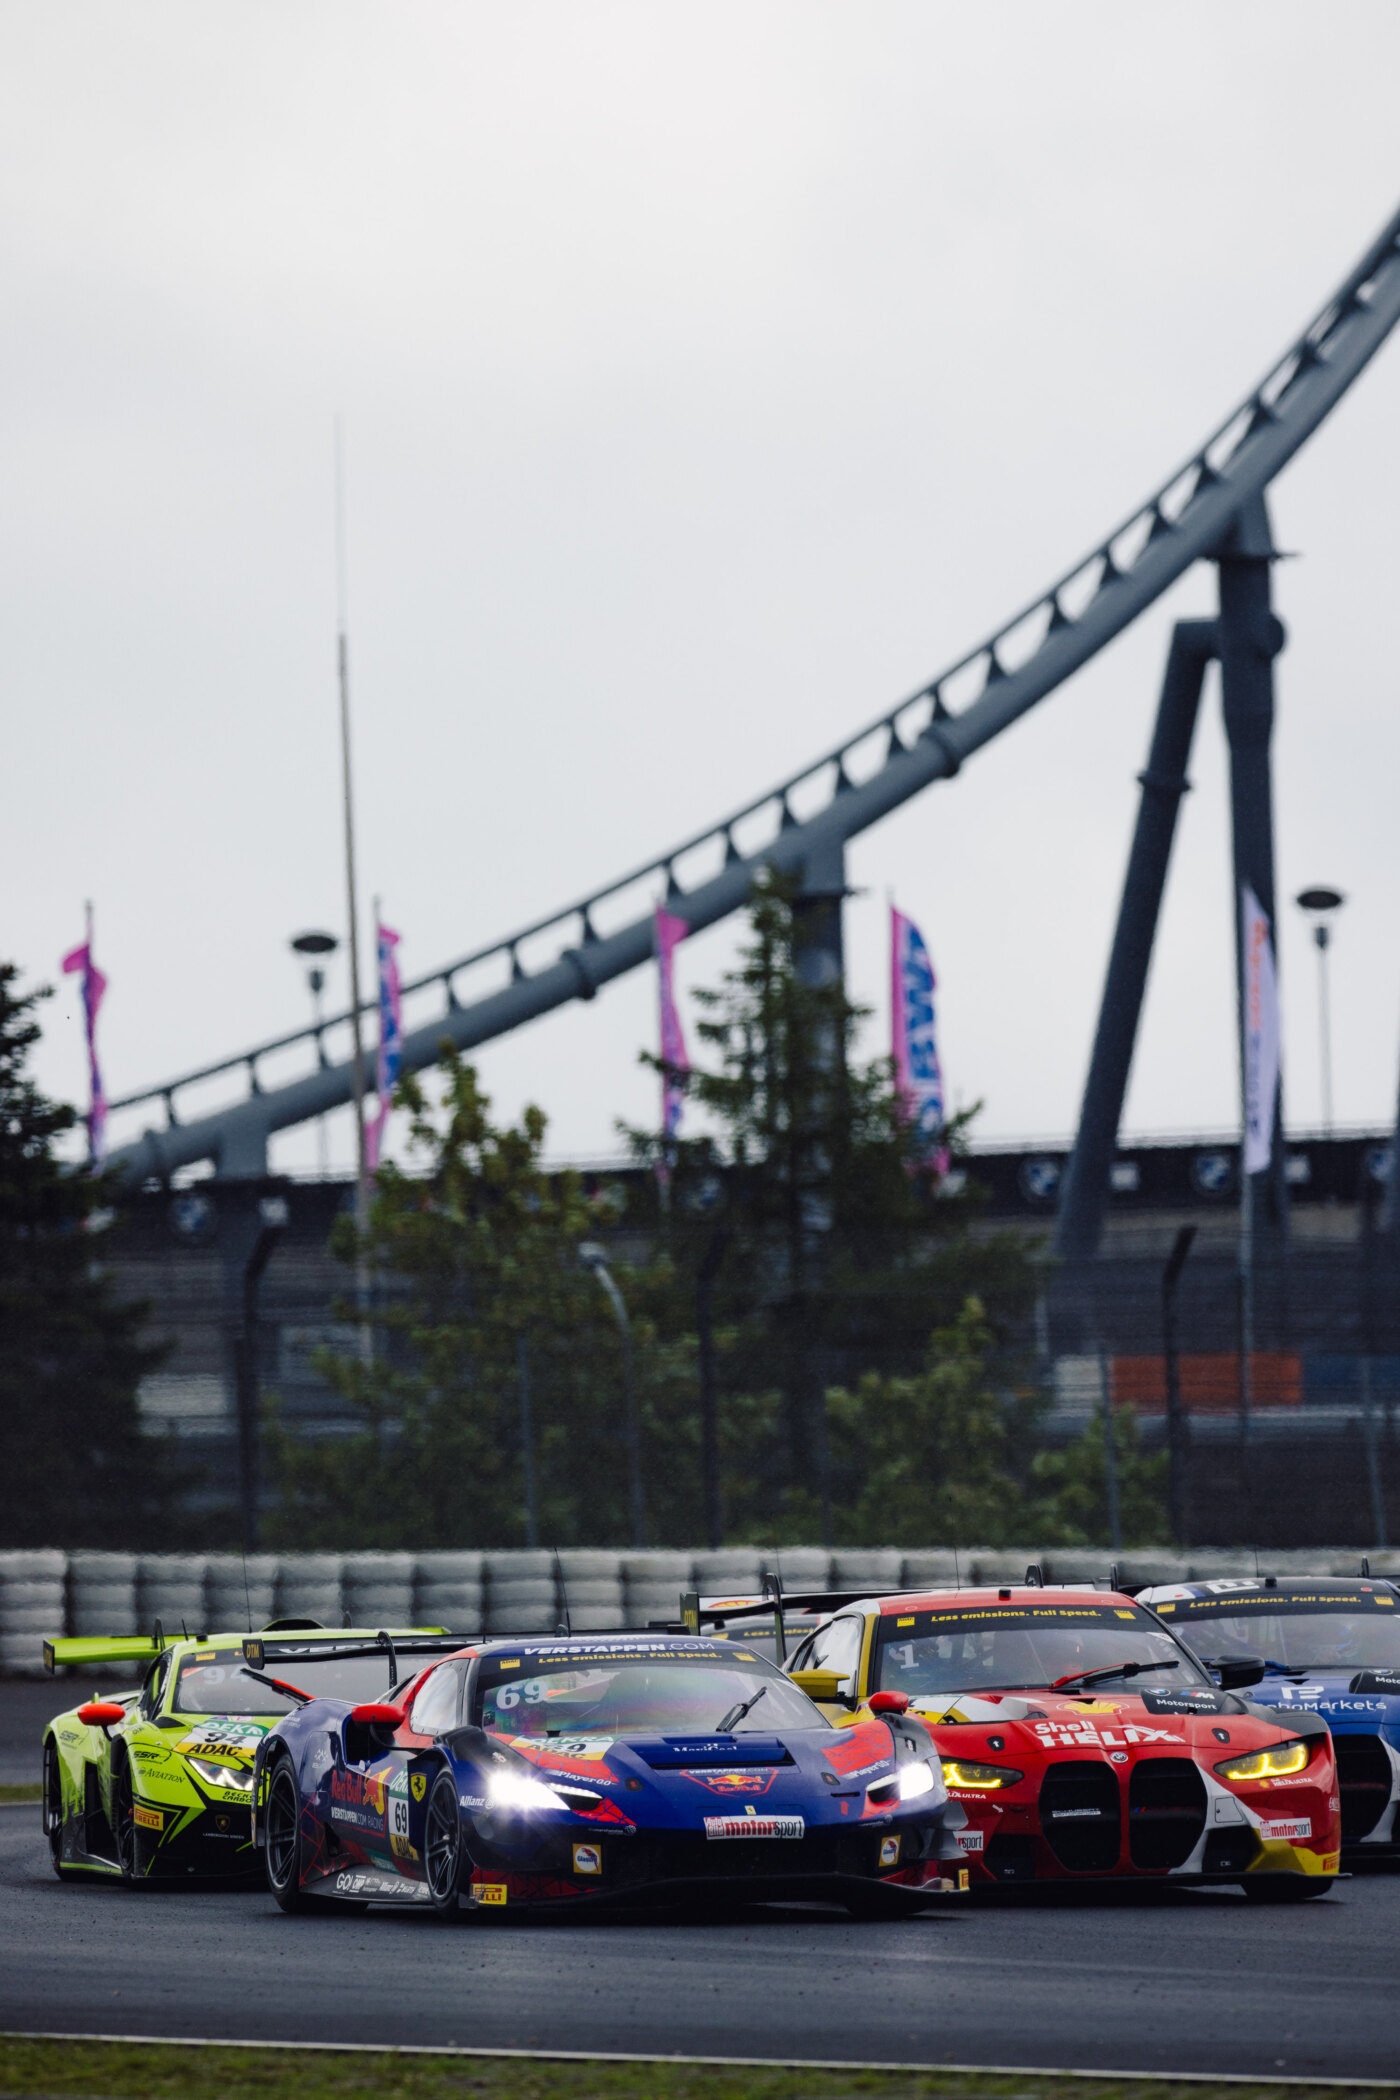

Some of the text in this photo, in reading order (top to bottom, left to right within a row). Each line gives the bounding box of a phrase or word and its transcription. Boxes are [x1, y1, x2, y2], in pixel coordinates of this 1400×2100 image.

[1220, 1597, 1288, 1605] emissions.
[961, 1610, 1030, 1620] emissions.
[246, 1644, 260, 1658] DTM
[524, 1642, 714, 1655] VERSTAPPEN.COM
[571, 1653, 646, 1662] emissions.
[496, 1680, 549, 1710] 69
[1156, 1699, 1217, 1709] Motorsport
[1265, 1700, 1387, 1710] boMarkets
[1035, 1721, 1095, 1734] Shell
[1039, 1724, 1186, 1747] HELIX
[187, 1744, 242, 1756] ADAC
[331, 1770, 362, 1804] Red Bull
[460, 1795, 485, 1806] Allianz
[395, 1802, 407, 1833] 69
[725, 1820, 803, 1837] motorsport
[1271, 1822, 1311, 1837] motorsport
